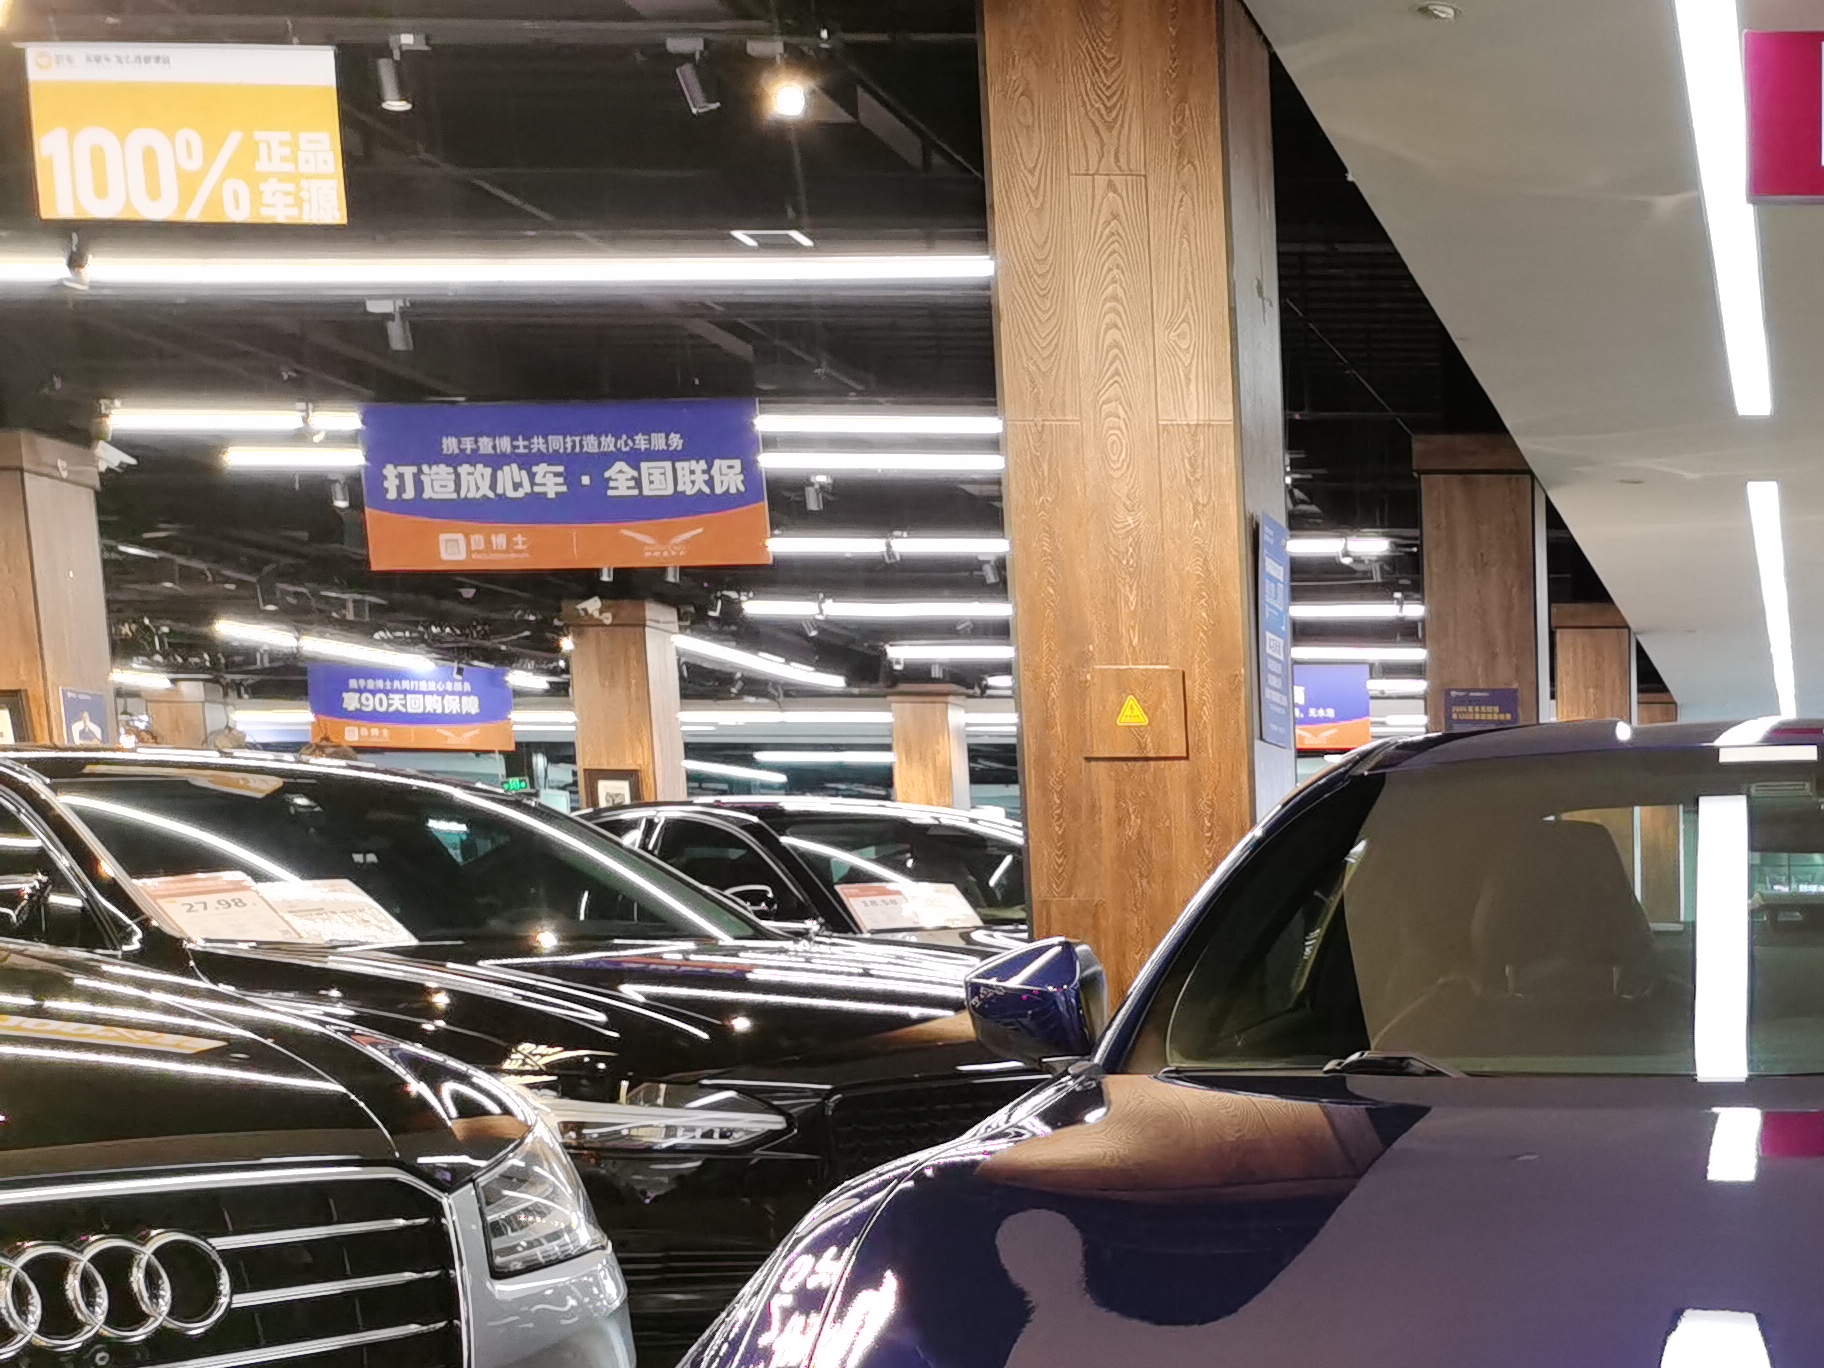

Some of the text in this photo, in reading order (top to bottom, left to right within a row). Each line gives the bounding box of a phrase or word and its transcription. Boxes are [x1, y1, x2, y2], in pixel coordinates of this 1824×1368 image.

[40, 126, 336, 221] 100% 正品
[258, 177, 341, 222] 车源
[441, 433, 685, 455] 携手查博士共同打造放心车服务
[382, 458, 746, 500] 打造放心车·全国联保
[342, 691, 480, 715] 享90天回购保障
